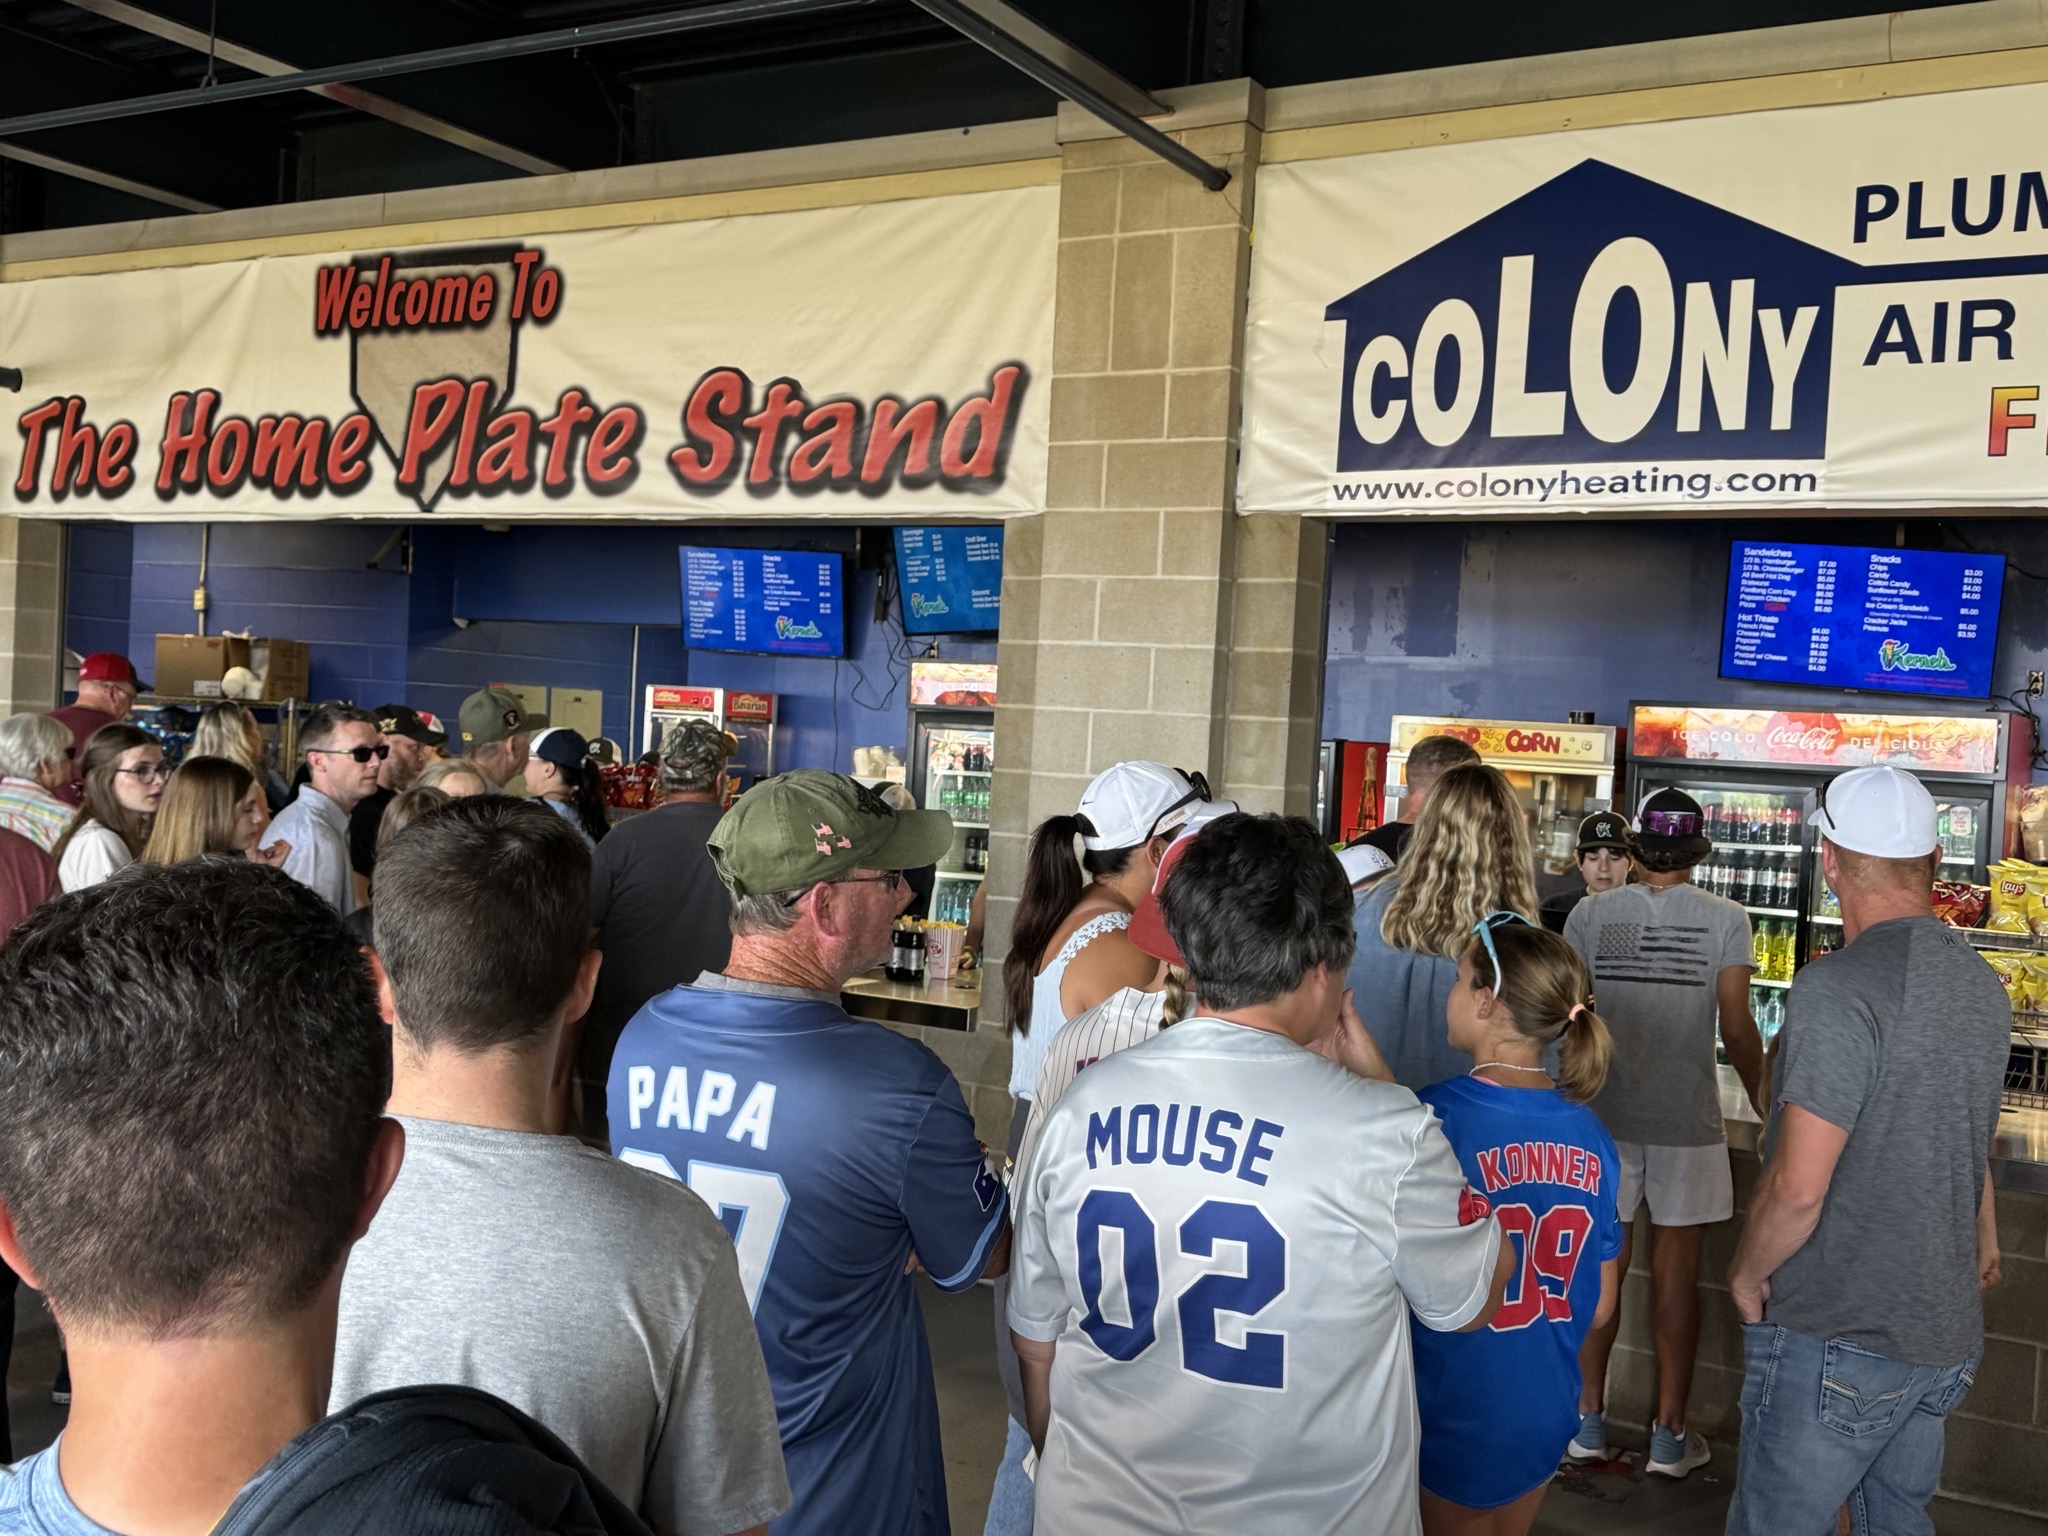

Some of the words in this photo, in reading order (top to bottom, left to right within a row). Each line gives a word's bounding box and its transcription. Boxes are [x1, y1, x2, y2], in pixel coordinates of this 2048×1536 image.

[314, 256, 496, 333] Welcome
[512, 251, 560, 321] To
[1352, 236, 1821, 447] COLONY
[1862, 299, 2016, 366] AIR
[15, 396, 135, 494] The
[156, 388, 373, 492] Home
[398, 376, 641, 490] Plate
[669, 364, 1024, 487] Stand
[1987, 385, 2048, 457] F
[1332, 466, 1819, 502] www.colonyheating.com
[1743, 547, 1793, 558] Sandwiches
[1762, 558, 1797, 566] Hamburger
[1870, 554, 1902, 564] Snacks
[1762, 565, 1805, 574] Cheeseburger
[1777, 574, 1791, 582] Dog
[1868, 571, 1890, 580] Candy
[1869, 563, 1888, 571] Chips
[1964, 569, 1983, 577] $3.00
[1867, 579, 1889, 587] Cotton
[1889, 580, 1911, 589] Candy
[1962, 584, 1981, 592] $4.00
[1898, 588, 1920, 596] Seeds
[1961, 592, 1981, 600] $4.00
[1875, 602, 1898, 610] Cream
[1898, 603, 1930, 612] Sandwich
[1738, 613, 1752, 622] Hot
[1754, 614, 1779, 624] Treats
[1863, 616, 1889, 625] Cracker
[1863, 624, 1889, 632] Peanuts
[1736, 630, 1760, 638] Cheese
[1760, 631, 1776, 639] Fries
[1879, 640, 1957, 671] Kernels
[1504, 729, 1561, 754] CORN
[1672, 729, 1701, 742] ICE
[1709, 731, 1755, 743] COLD
[1766, 726, 1840, 751] Coca-Cola
[627, 1066, 777, 1150] PAPA
[1086, 1103, 1285, 1187] MOUSE
[1476, 1142, 1601, 1196] KONNER
[618, 1146, 791, 1320] 7
[1487, 1203, 1594, 1332] 09
[1076, 1185, 1290, 1393] 02
